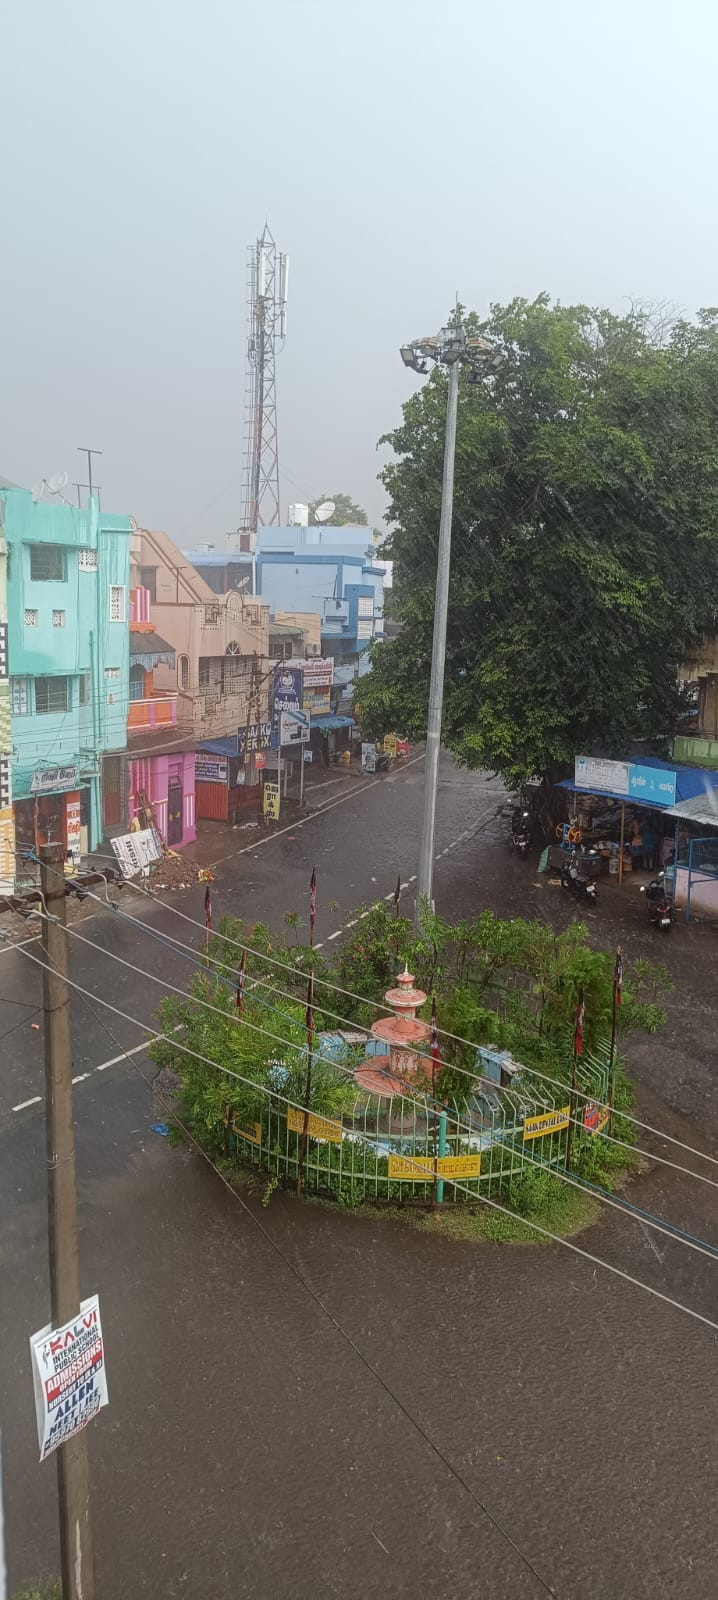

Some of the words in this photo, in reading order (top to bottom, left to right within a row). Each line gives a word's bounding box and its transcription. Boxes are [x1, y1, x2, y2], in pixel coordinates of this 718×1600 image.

[50, 1310, 97, 1355] KALVI
[53, 1325, 99, 1363] INTERNATIONAL
[54, 1351, 77, 1373] PUBLIC
[78, 1333, 99, 1354] SCHOOL
[47, 1340, 102, 1394] ADMISSIONS
[50, 1407, 76, 1437] NEET
[84, 1387, 99, 1410] JEE
[55, 1378, 94, 1421] ALLEN
